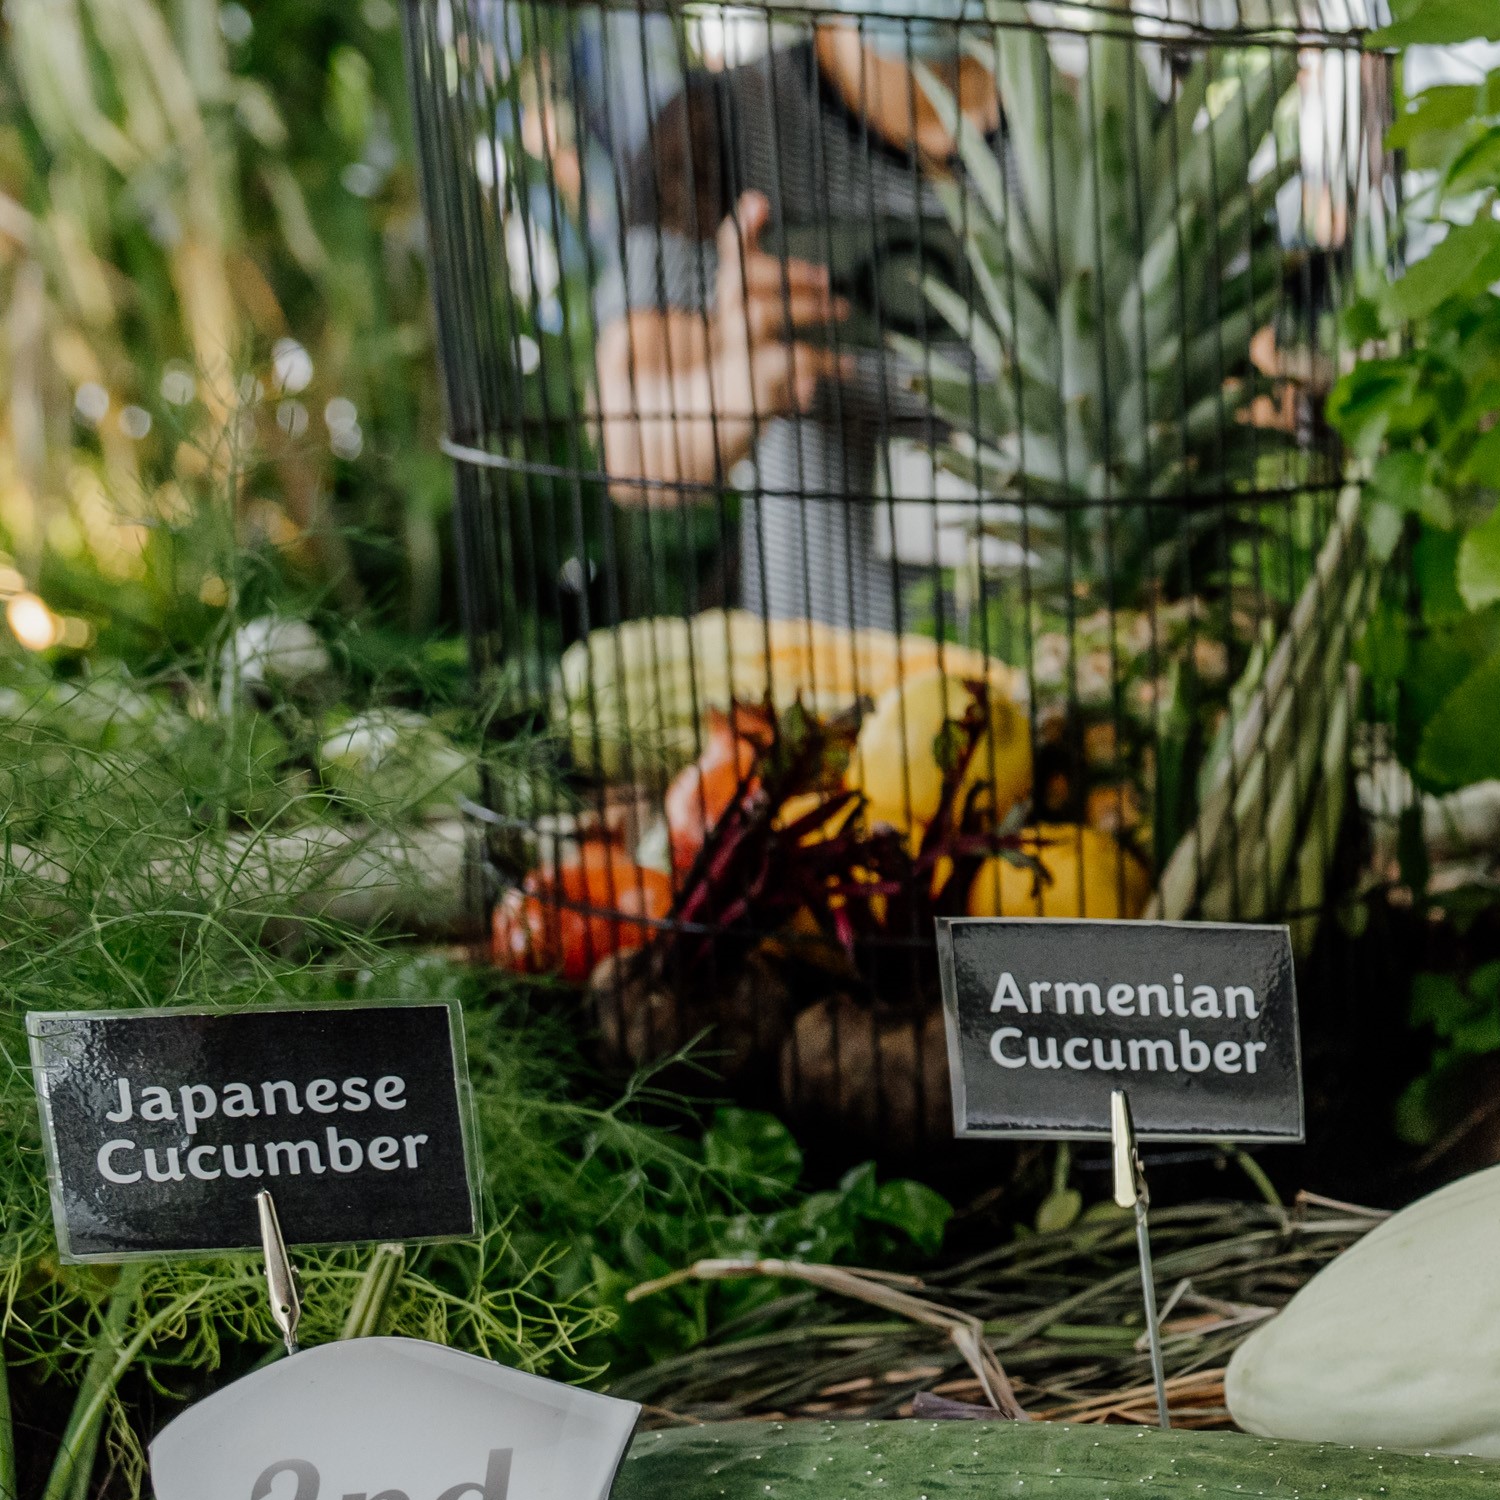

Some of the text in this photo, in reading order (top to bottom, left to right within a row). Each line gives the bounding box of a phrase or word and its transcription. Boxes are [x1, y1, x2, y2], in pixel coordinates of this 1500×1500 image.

[989, 971, 1260, 1020] Armenian
[989, 1026, 1267, 1074] Cucumber
[105, 1075, 407, 1134] Japanese
[98, 1126, 428, 1184] Cucumber
